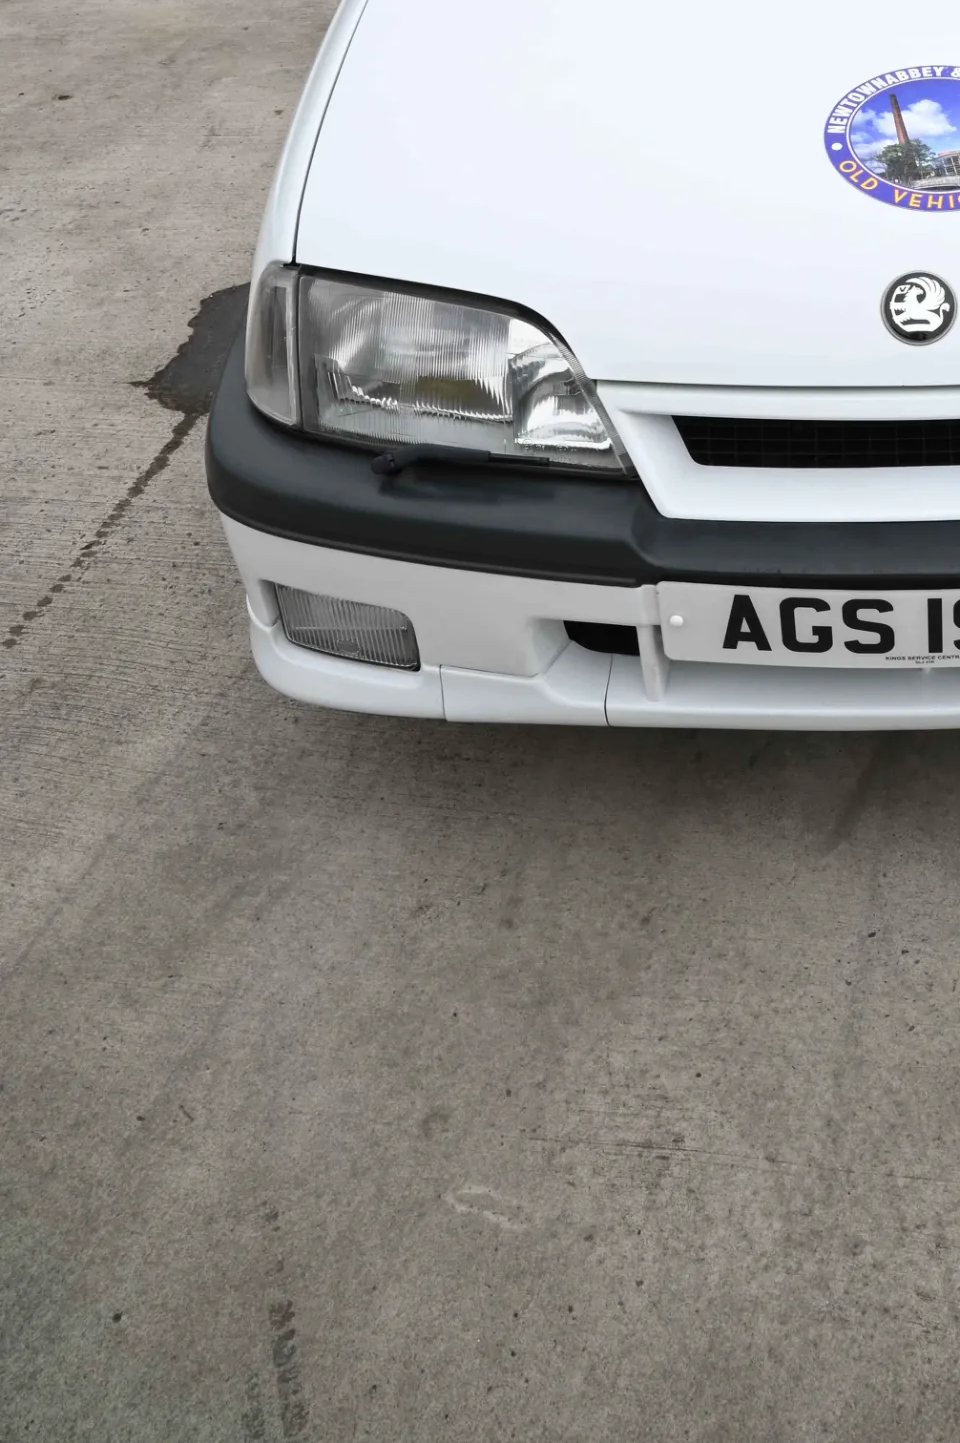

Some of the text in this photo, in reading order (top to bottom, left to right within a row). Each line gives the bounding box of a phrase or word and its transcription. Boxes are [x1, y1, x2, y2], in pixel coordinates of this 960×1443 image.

[827, 66, 946, 134] NEWTOWNABBEY
[839, 160, 879, 191] OLD
[722, 594, 895, 654] AGS
